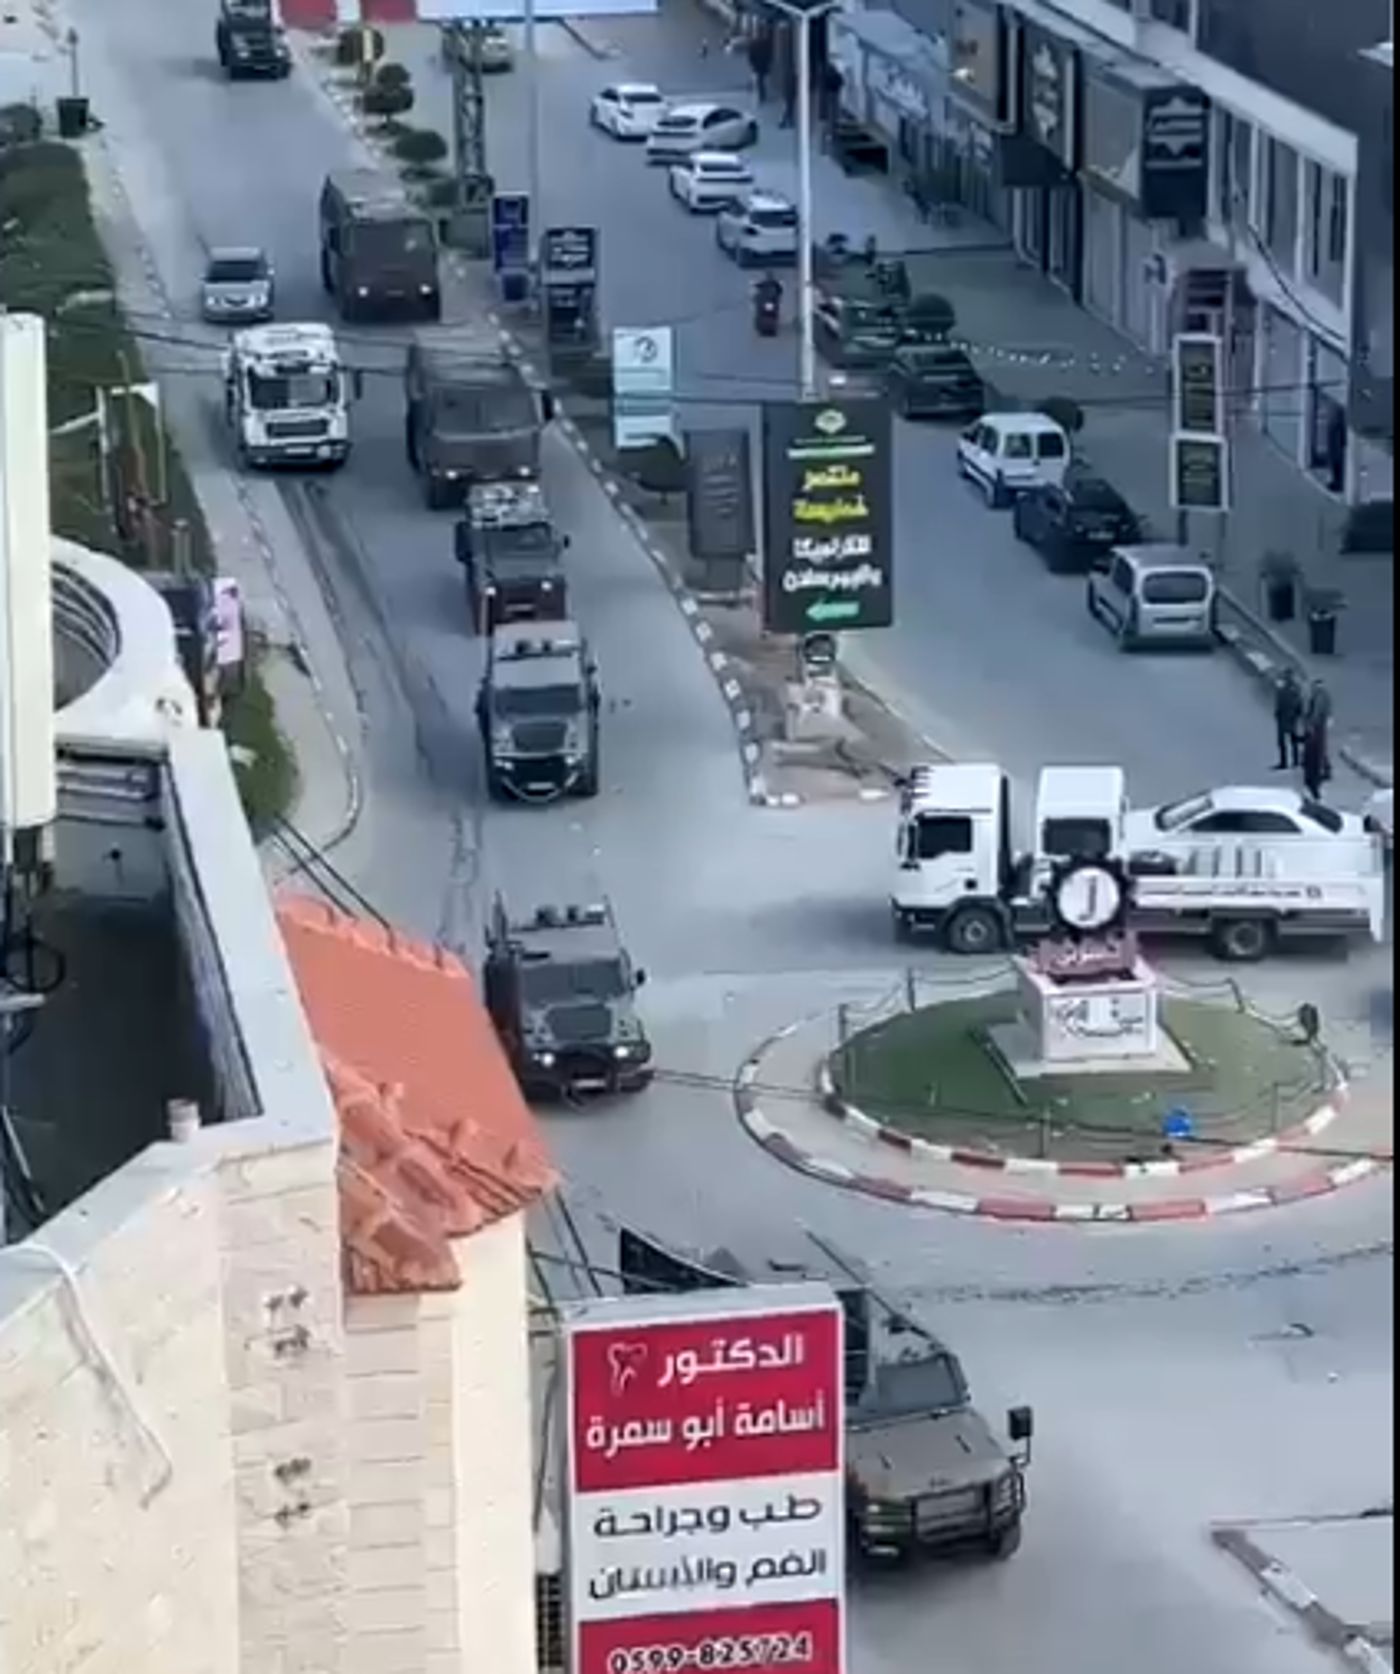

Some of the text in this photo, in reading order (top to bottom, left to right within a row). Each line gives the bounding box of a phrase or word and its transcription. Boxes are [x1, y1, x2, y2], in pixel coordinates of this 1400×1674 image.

[656, 1333, 804, 1388] الدكتور
[585, 1389, 825, 1459] أسامة أبو سمرة
[593, 1494, 822, 1538] طب وجراحة
[745, 1547, 827, 1590] الفم
